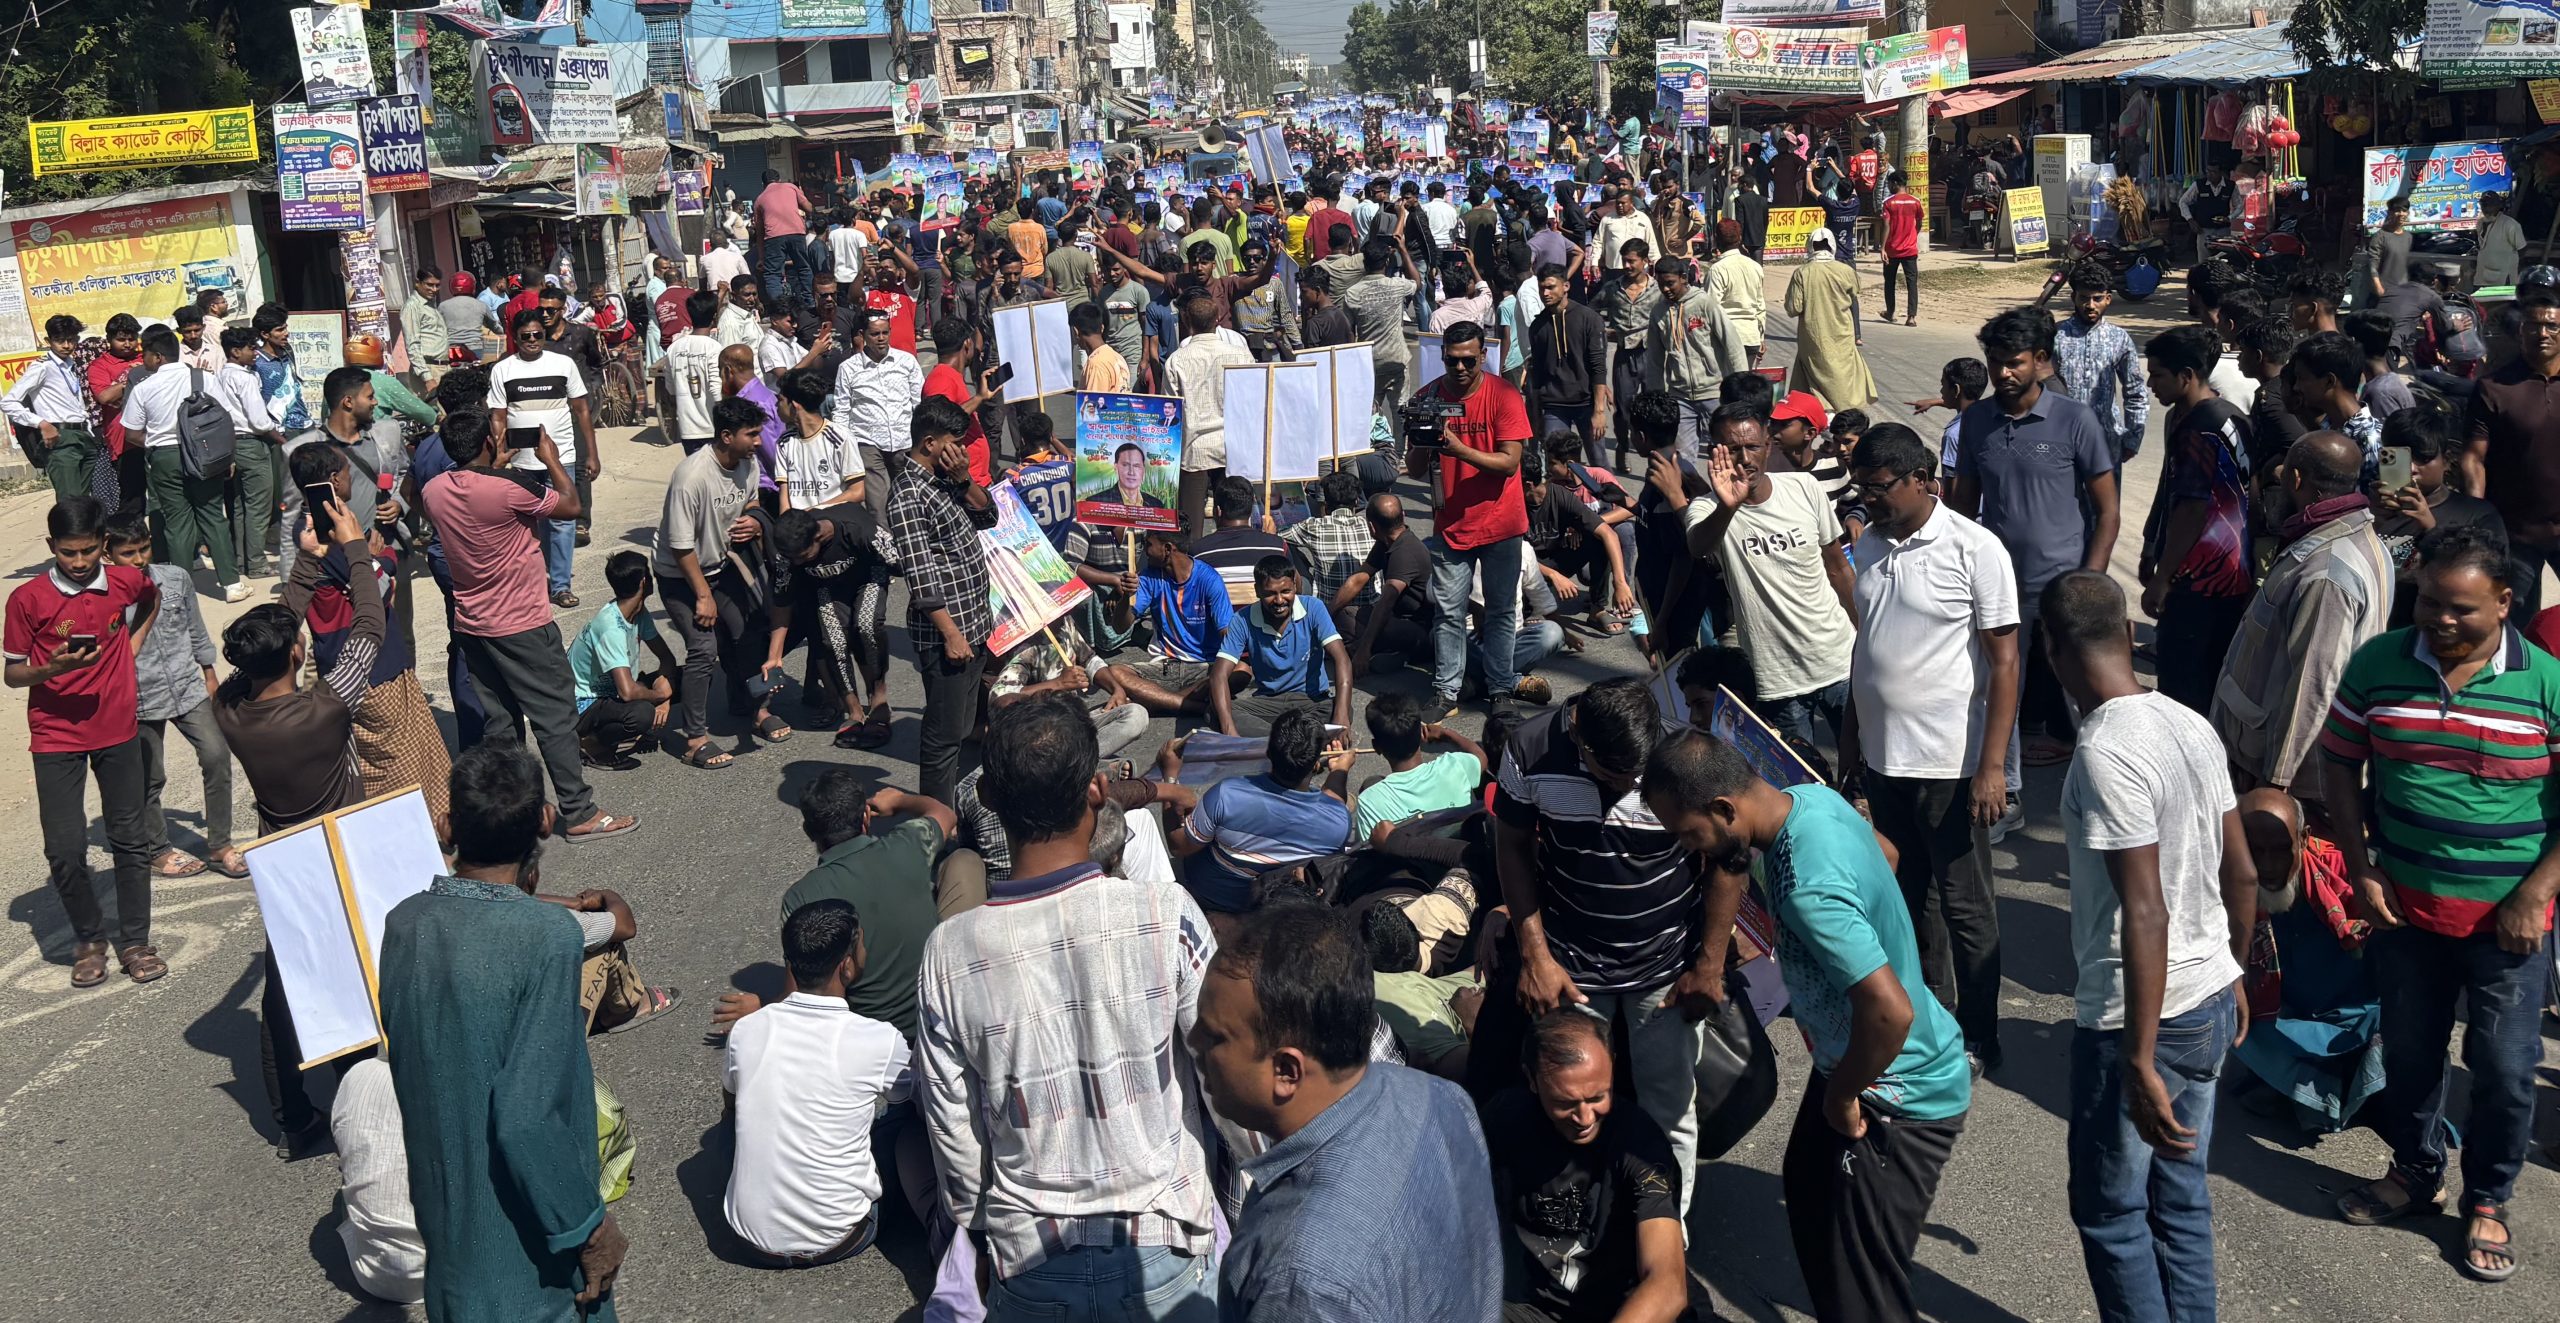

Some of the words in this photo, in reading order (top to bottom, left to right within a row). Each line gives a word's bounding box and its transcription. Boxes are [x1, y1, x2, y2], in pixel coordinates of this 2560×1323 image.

[487, 46, 554, 84] টুংগীপাড়া
[560, 58, 610, 83] এক্সপ্রেস
[279, 113, 323, 128] তানযীমুল
[326, 113, 352, 125] উম্মাহ
[361, 99, 421, 146] টুংগীপাড়া
[70, 134, 108, 153] বিল্লাহ
[111, 130, 160, 150] ক্যাডেট
[166, 125, 208, 145] কোচিং
[368, 139, 424, 173] কাউন্টার
[2369, 154, 2405, 187] রনি
[2409, 154, 2448, 186] ড্রাগ
[2452, 147, 2507, 180] হাউজ
[518, 385, 553, 393] Tomorrow
[1020, 465, 1070, 486] CHOWDHURY
[714, 489, 745, 510] DIOR
[1027, 480, 1072, 527] 30
[1742, 527, 1807, 557] RISE
